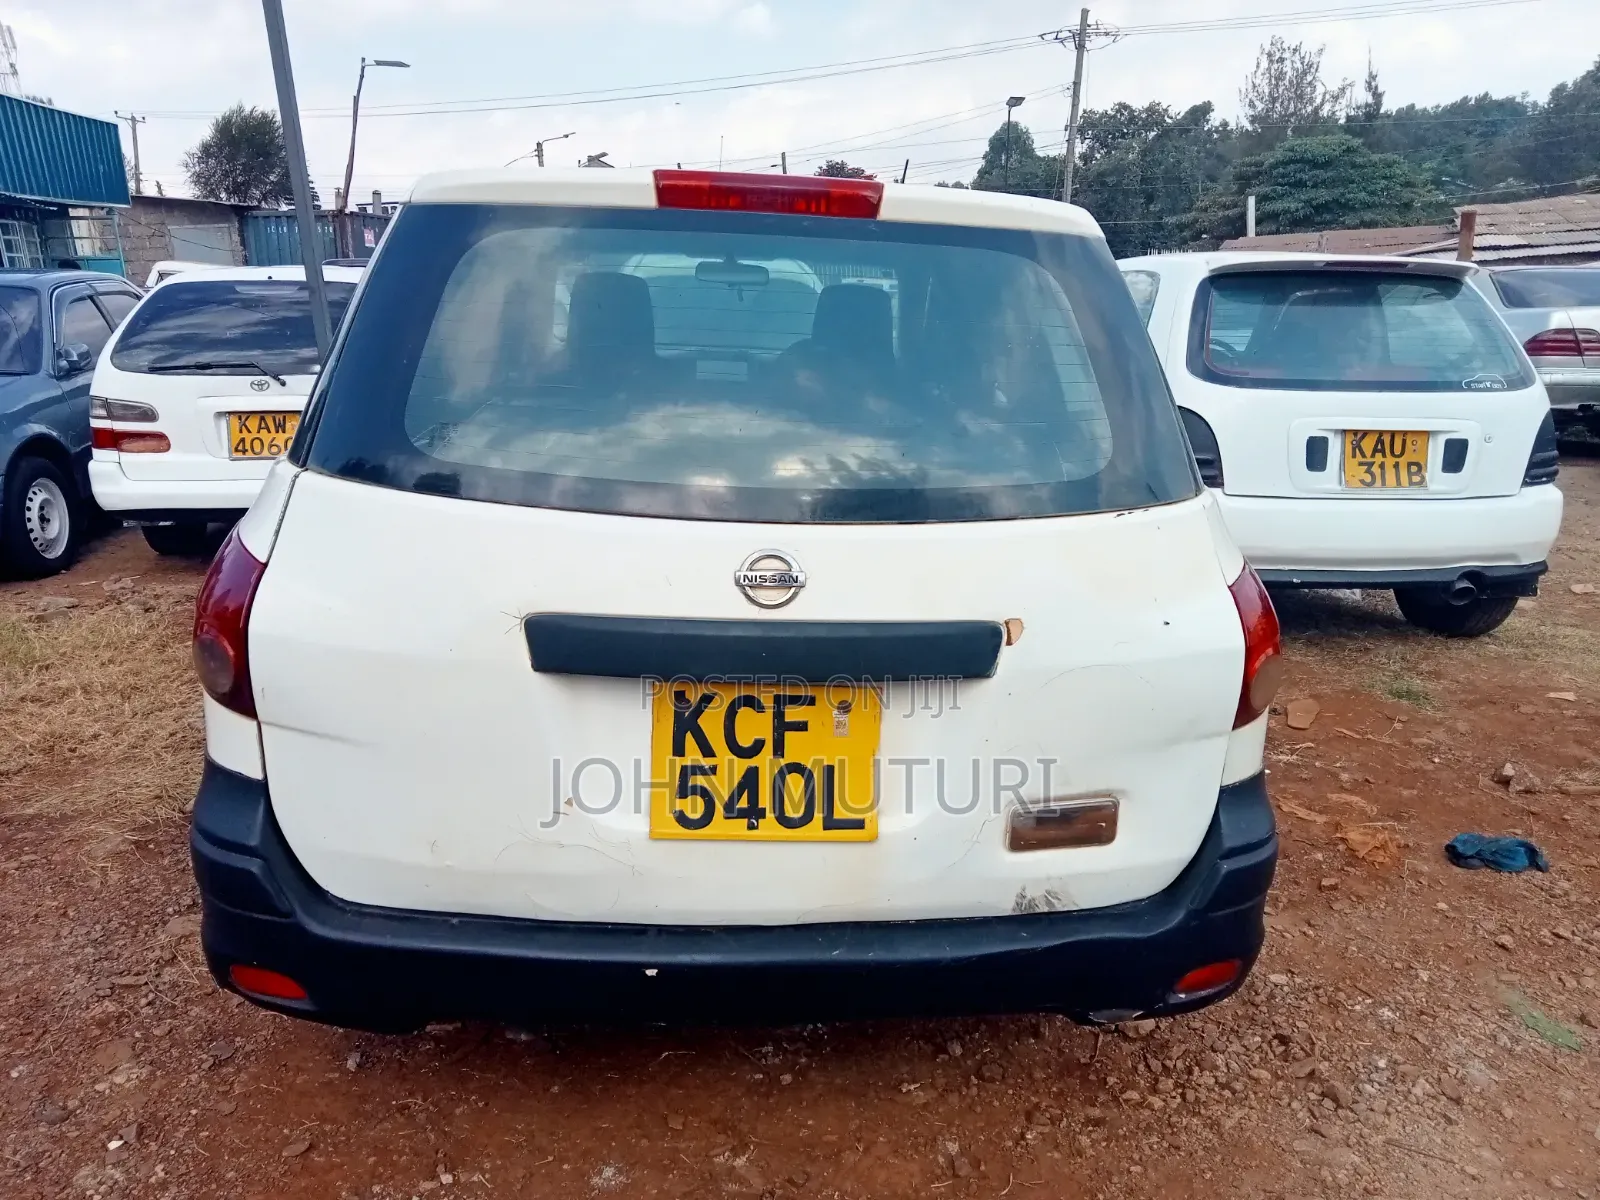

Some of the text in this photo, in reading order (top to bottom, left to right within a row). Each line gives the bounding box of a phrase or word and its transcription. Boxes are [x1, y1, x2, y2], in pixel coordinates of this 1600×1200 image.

[237, 414, 287, 434] KAW
[1351, 431, 1407, 459] KAU
[1357, 460, 1426, 487] 311B
[742, 574, 799, 584] NISSAN
[672, 690, 816, 759] KCF
[672, 761, 866, 831] 540L
